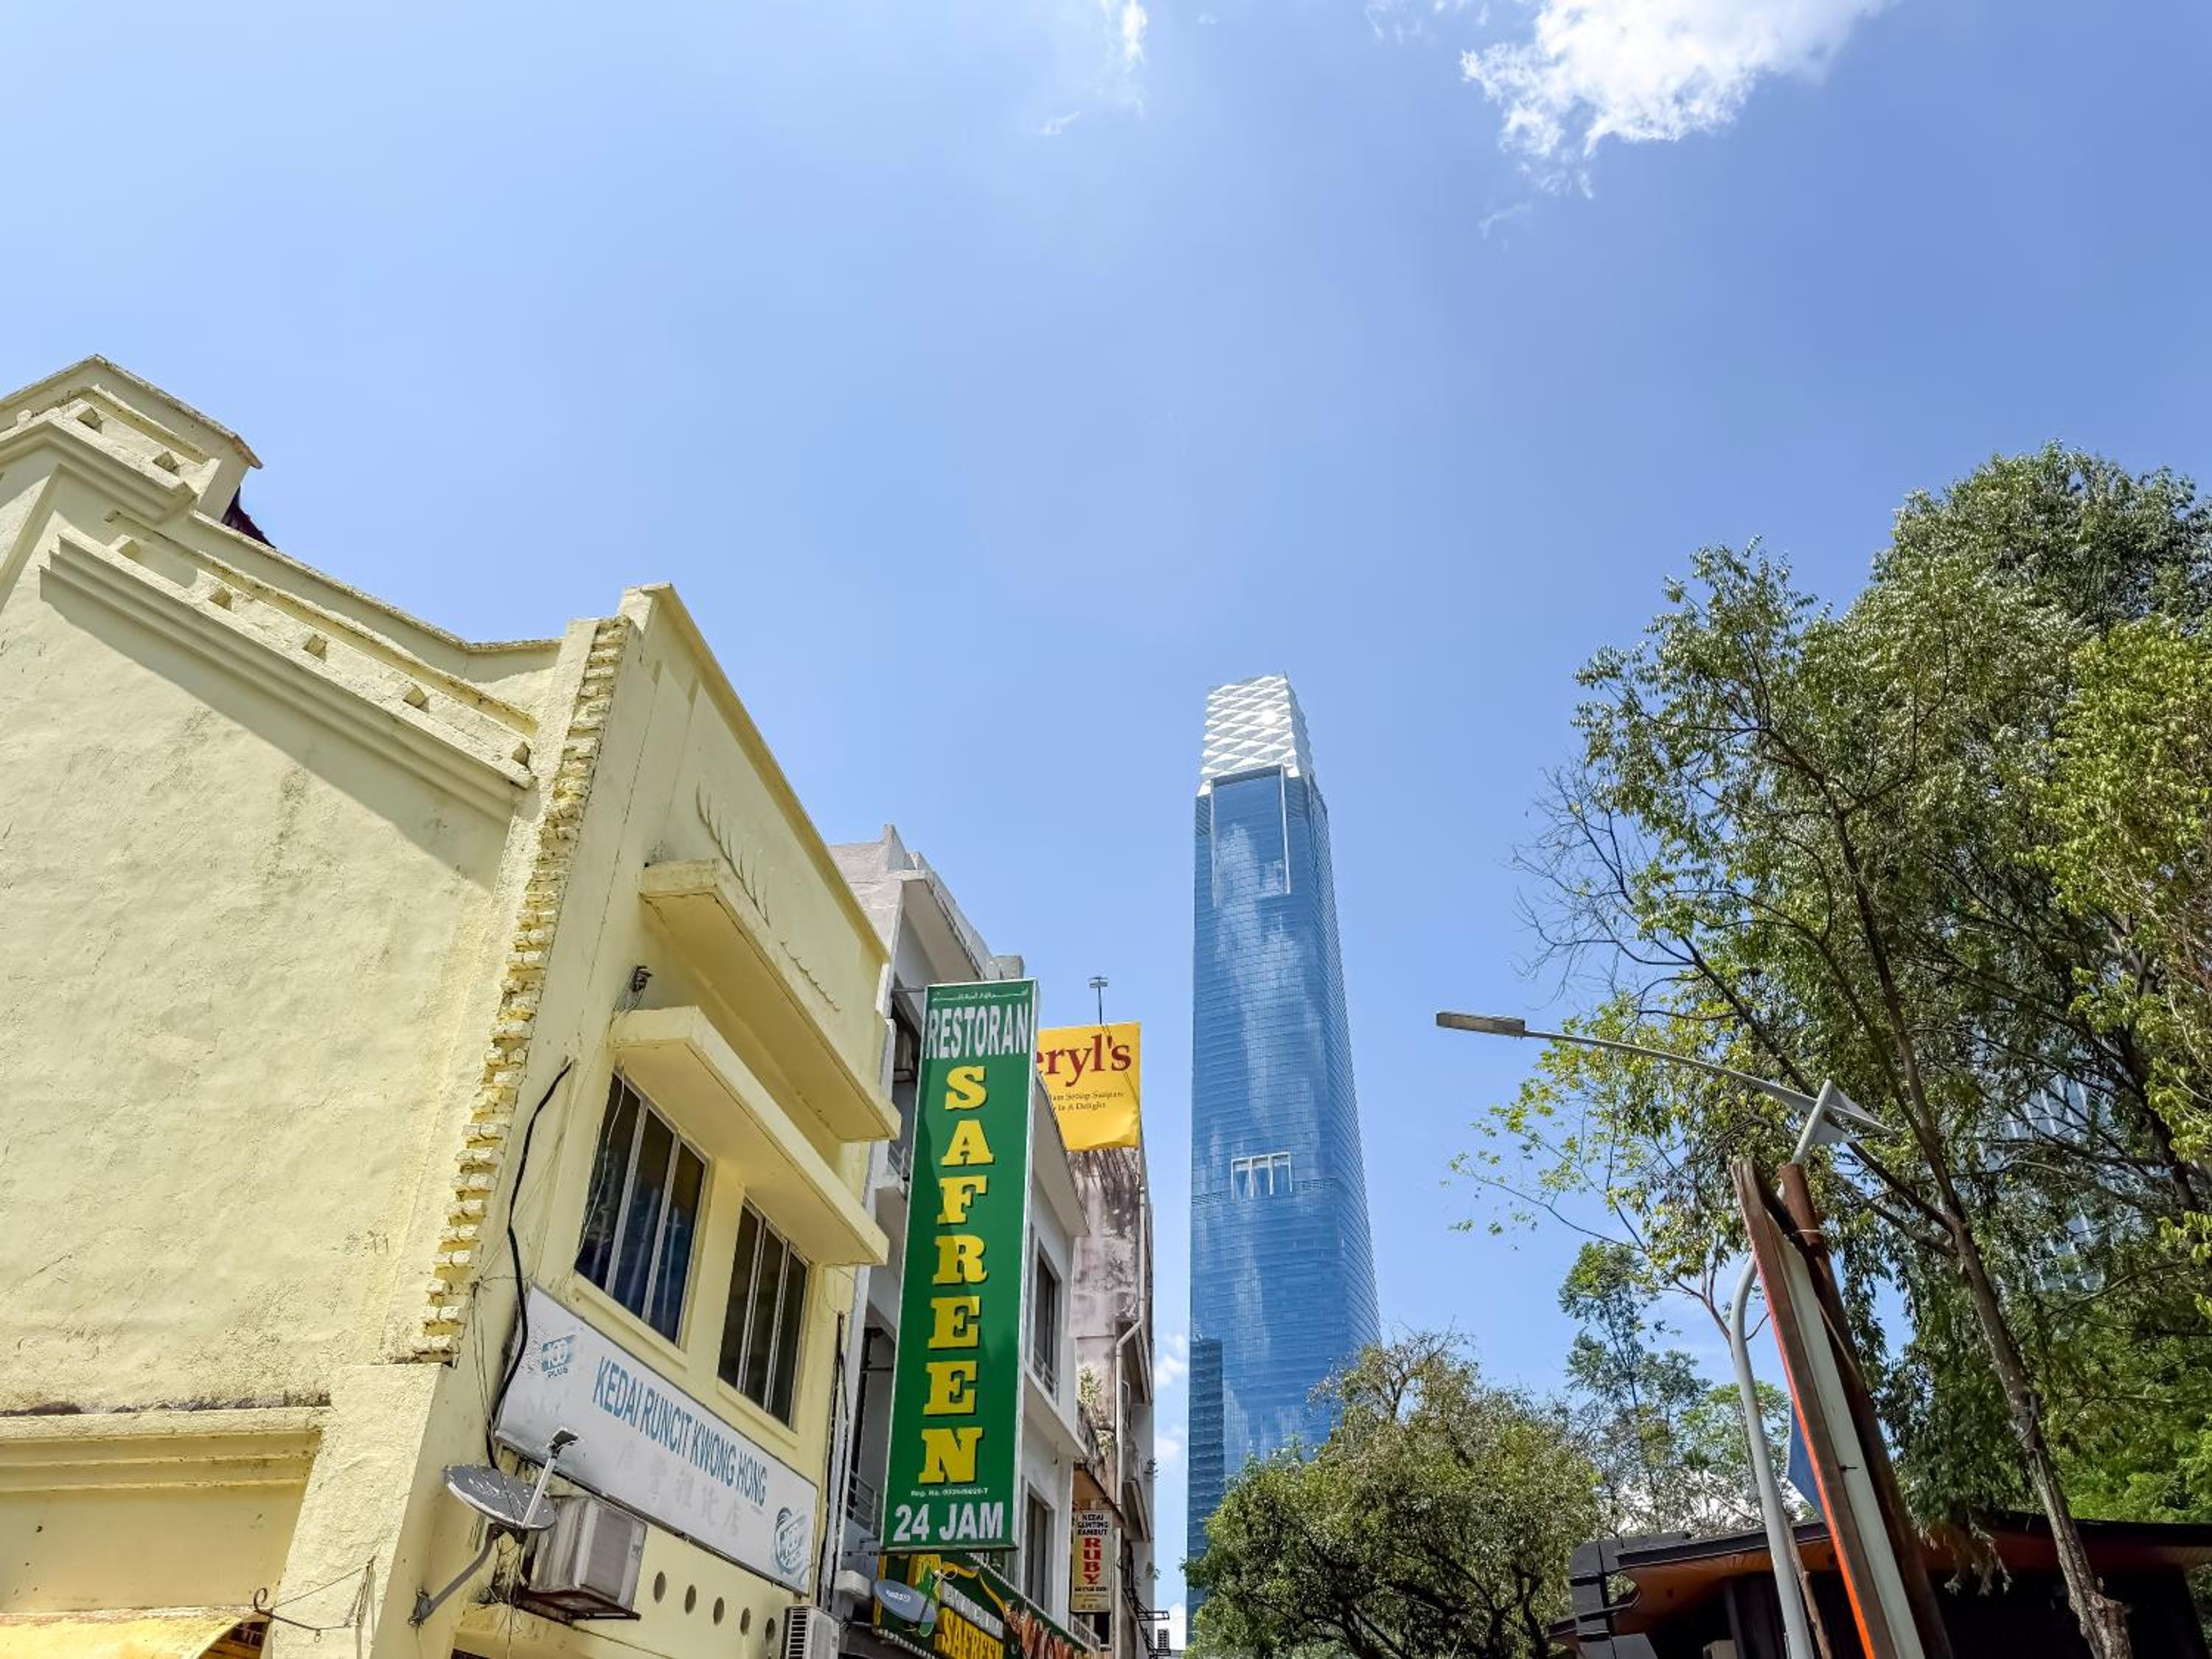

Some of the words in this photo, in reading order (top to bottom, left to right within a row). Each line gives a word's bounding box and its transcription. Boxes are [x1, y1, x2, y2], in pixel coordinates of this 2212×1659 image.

[926, 1004, 1029, 1060] RESTORAN
[919, 1065, 995, 1485] SAFREEN
[592, 1356, 644, 1427] KEDAI
[639, 1387, 693, 1458] RUNCIT
[689, 1420, 737, 1487] KWONG
[736, 1450, 768, 1507] HONG
[893, 1503, 931, 1542] 24
[939, 1501, 1004, 1541] JAM
[1083, 1537, 1101, 1585] RUBY
